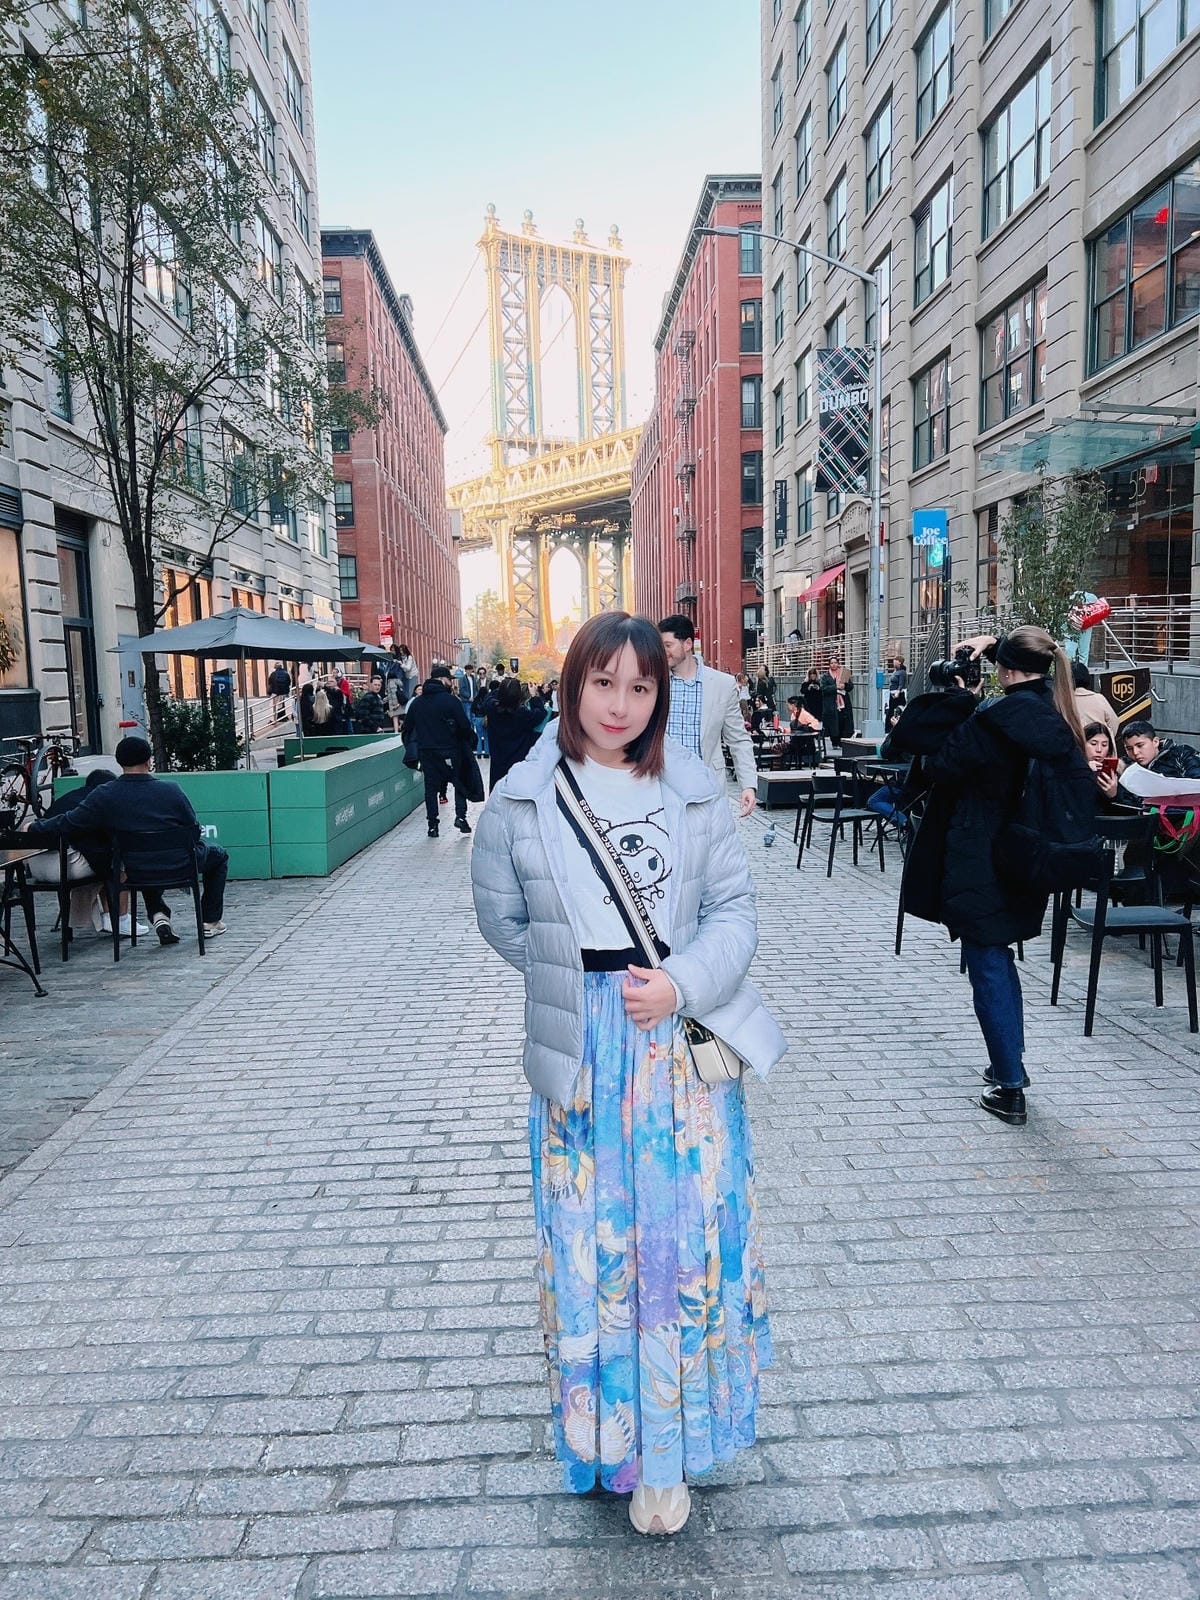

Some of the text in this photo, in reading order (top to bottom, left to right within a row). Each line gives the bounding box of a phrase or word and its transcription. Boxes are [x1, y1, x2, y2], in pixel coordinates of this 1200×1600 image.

[819, 389, 869, 413] DUMBO
[920, 526, 941, 537] Joe
[912, 535, 948, 546] Coffee
[218, 683, 226, 694] P
[1113, 683, 1134, 699] ups
[579, 799, 657, 941] THE SNAPSHOT MARC JACOBS
